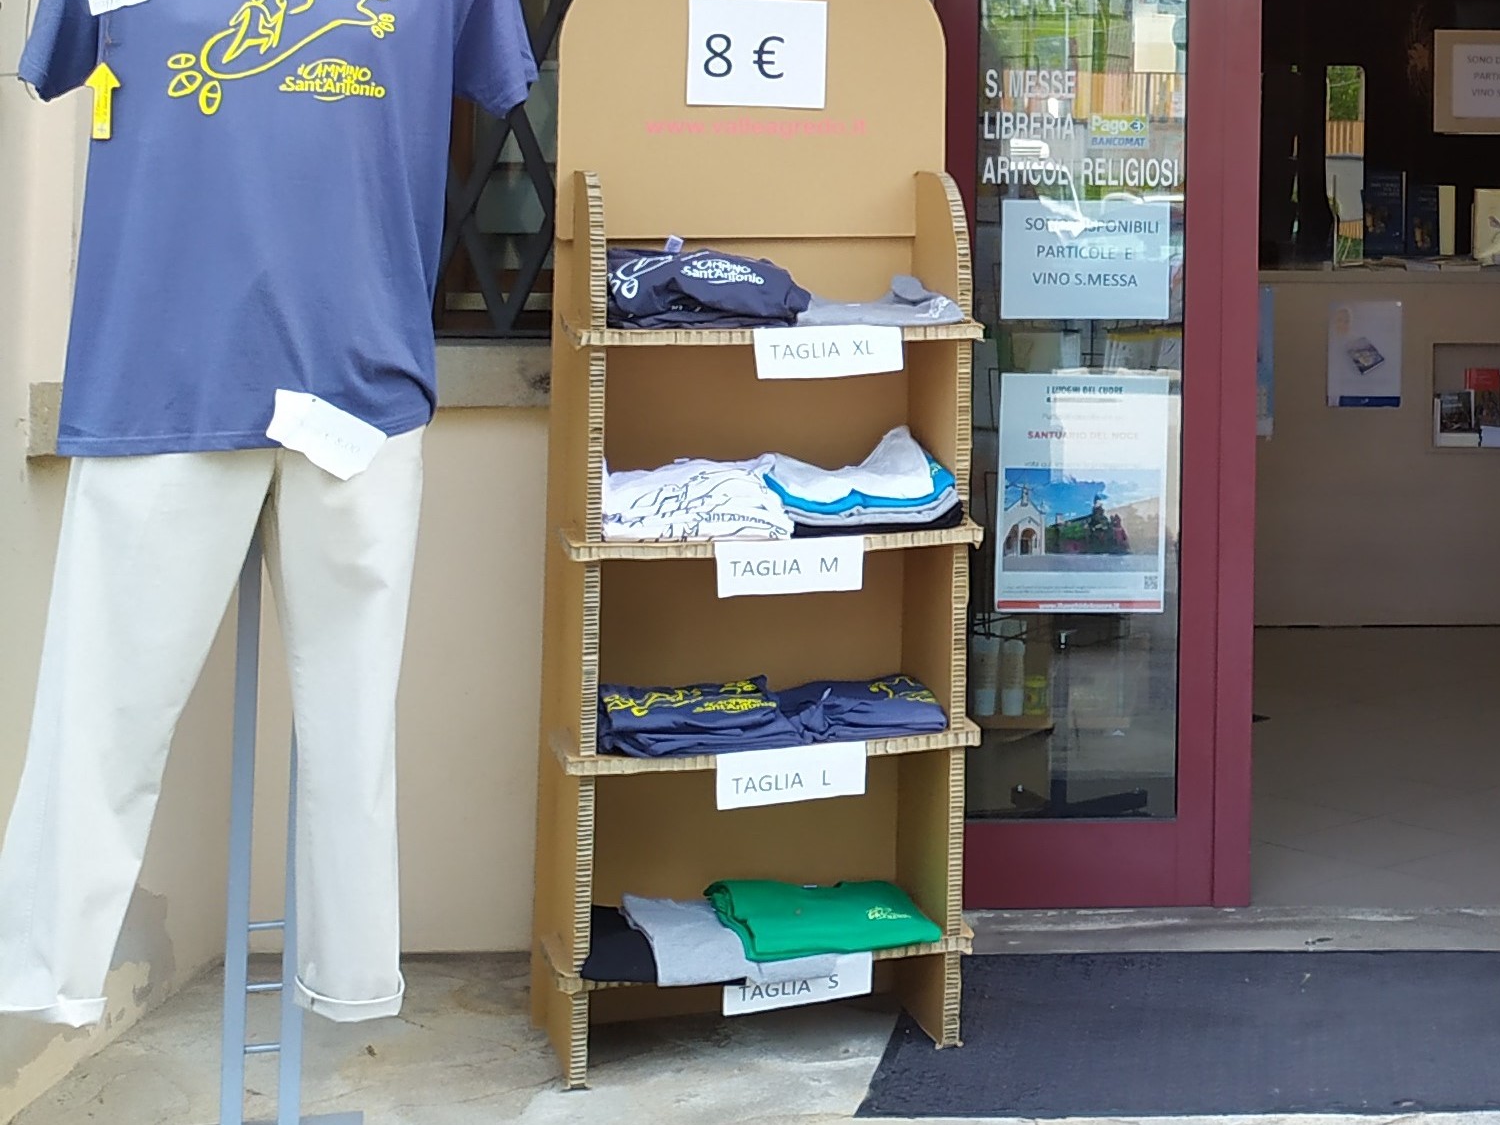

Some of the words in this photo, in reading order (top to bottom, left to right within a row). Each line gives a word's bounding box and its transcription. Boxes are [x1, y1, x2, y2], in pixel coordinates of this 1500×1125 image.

[703, 33, 733, 78] 8
[752, 35, 786, 80] €
[283, 76, 386, 98] Sant'Antonio
[985, 69, 1003, 98] S.
[1009, 70, 1077, 100] MESSE
[983, 111, 1076, 140] LIBRERIA
[1091, 137, 1146, 147] BANCOMAT
[982, 156, 1075, 186] ARTICOLI
[1081, 157, 1179, 187] RELIGIOSI
[1036, 245, 1116, 261] PARTICOLE
[1125, 247, 1133, 261] E
[1032, 272, 1070, 286] VINO
[769, 341, 841, 361] TAGLIA
[852, 339, 875, 356] XL
[729, 557, 801, 578] TAGLIA
[818, 556, 840, 574] M
[732, 773, 804, 796] TAGLIA
[821, 769, 832, 787] L
[739, 979, 811, 1001] TAGLIA
[828, 974, 839, 989] S
